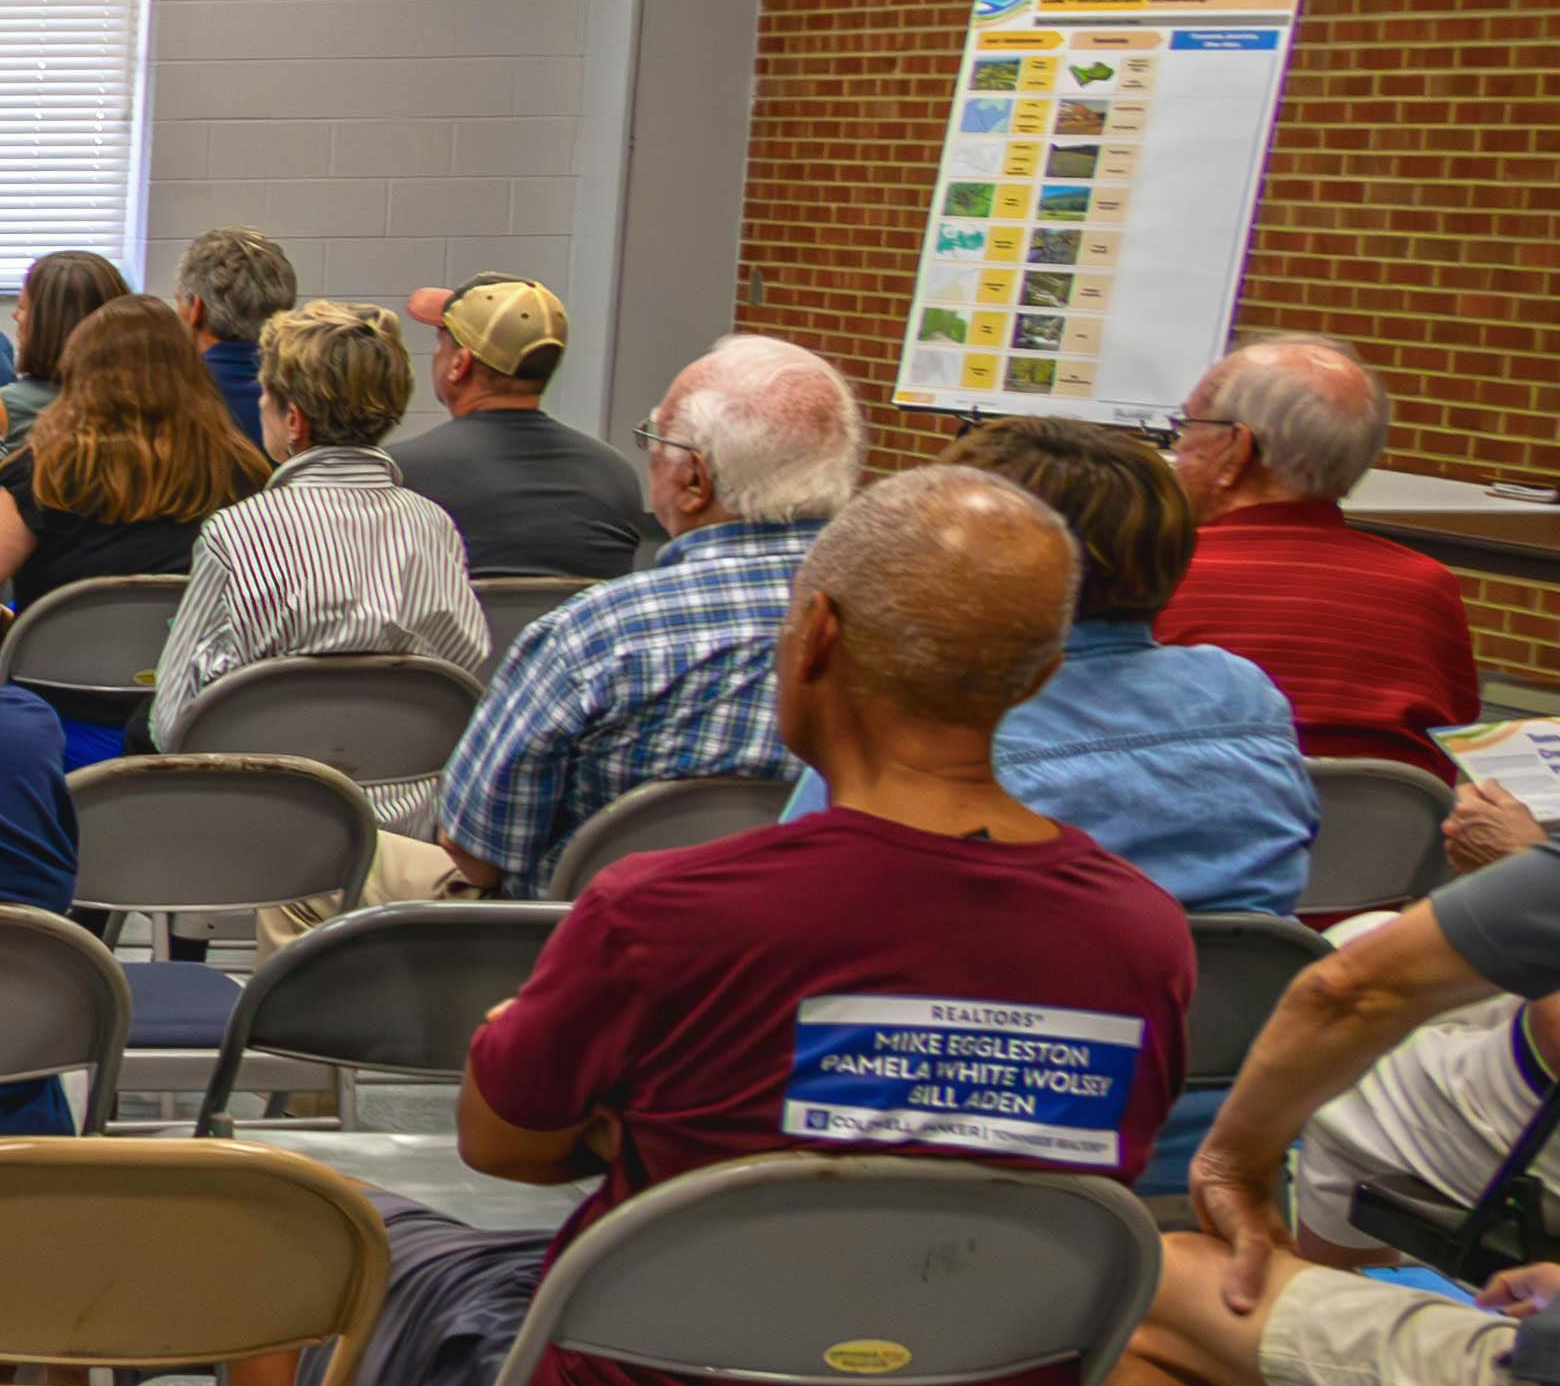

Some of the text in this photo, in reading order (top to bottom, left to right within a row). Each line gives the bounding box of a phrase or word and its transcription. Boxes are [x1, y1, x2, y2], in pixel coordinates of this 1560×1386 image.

[874, 1031, 1091, 1068] MIKE EGGLESTON
[820, 1054, 1113, 1097] PAMELA WHITE WOLSEY
[964, 1090, 1036, 1115] ADEN
